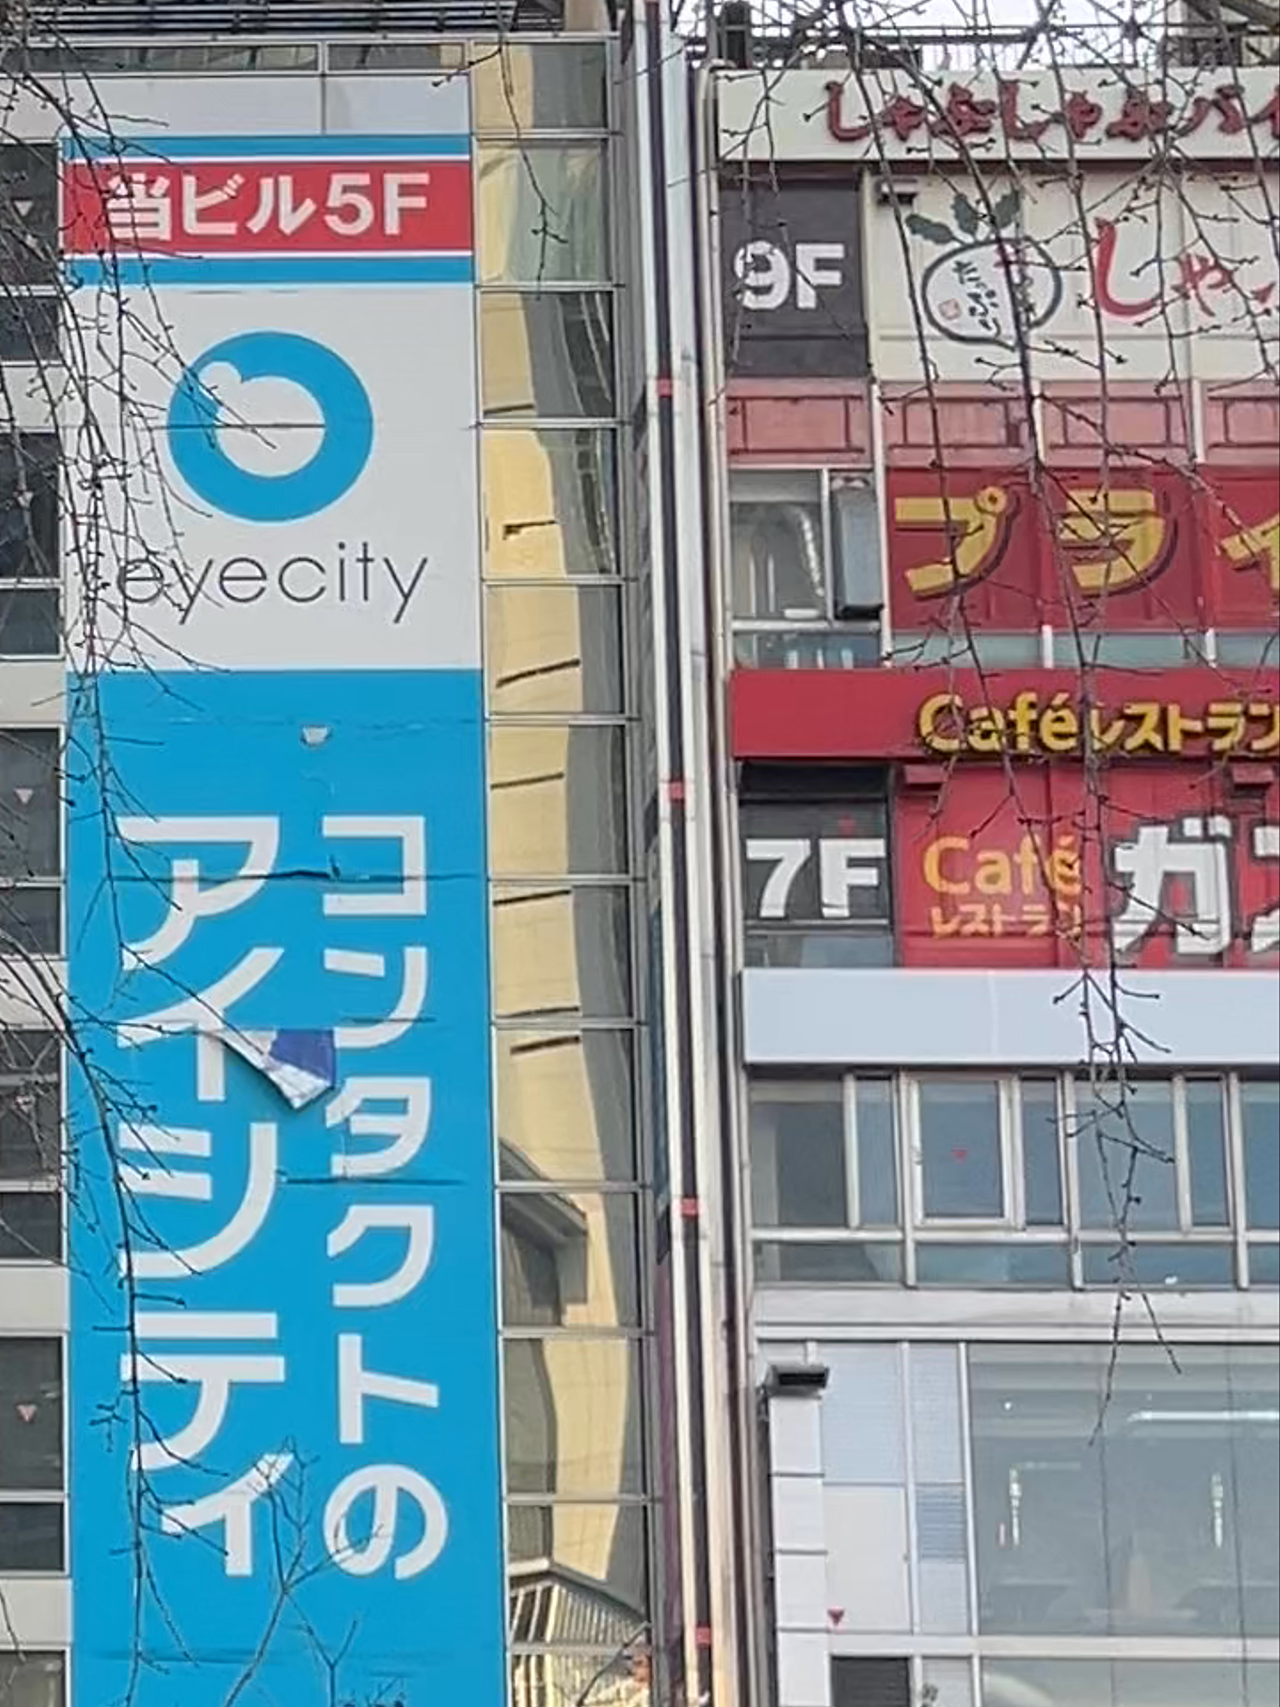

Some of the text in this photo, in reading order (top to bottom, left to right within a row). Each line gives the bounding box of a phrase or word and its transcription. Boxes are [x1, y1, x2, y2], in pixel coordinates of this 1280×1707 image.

[106, 172, 430, 241] 当ビル5F
[733, 240, 845, 311] 9F
[117, 542, 429, 625] eyecity
[744, 838, 887, 919] 7F
[922, 834, 1084, 896] Café
[116, 814, 295, 1578] アイシティ
[321, 814, 448, 1581] コンタクトの
